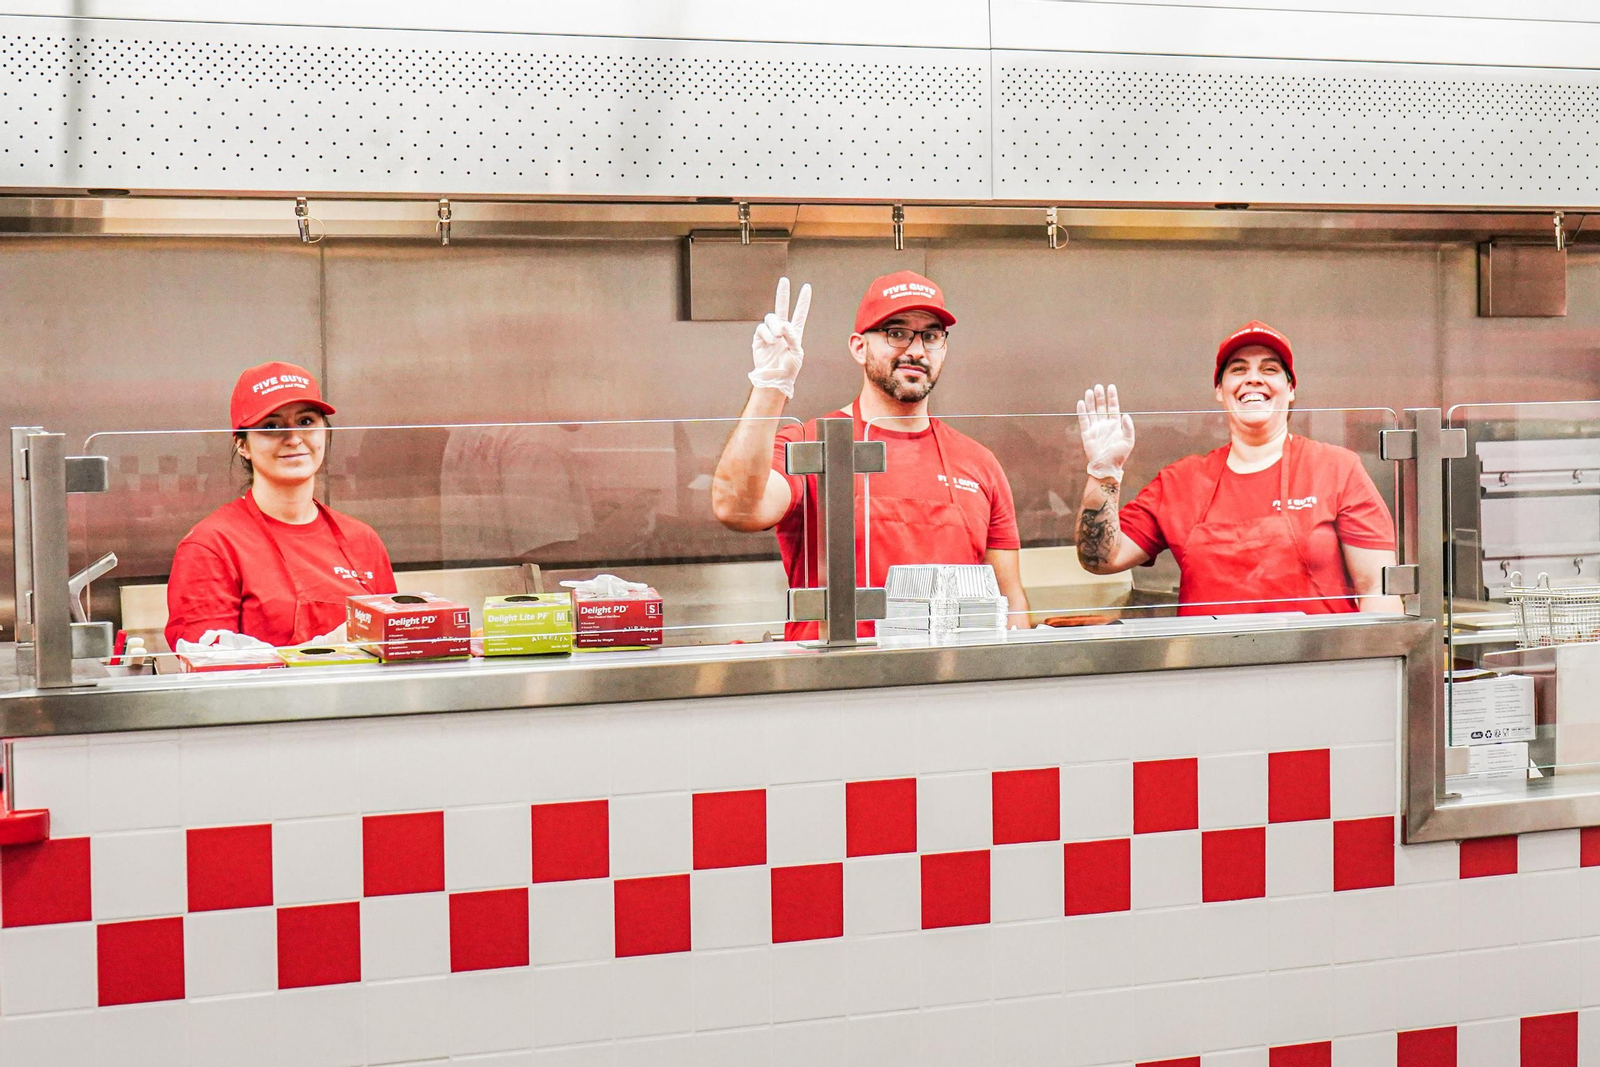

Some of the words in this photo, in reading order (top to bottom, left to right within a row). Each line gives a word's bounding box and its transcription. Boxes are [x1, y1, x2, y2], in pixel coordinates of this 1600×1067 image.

[882, 283, 907, 297] FIVE
[908, 282, 936, 296] GUYS
[252, 376, 279, 393] FIVE
[280, 374, 310, 385] GUYS
[958, 478, 979, 489] GUYS
[1293, 496, 1317, 506] GUYS
[351, 570, 374, 579] GS
[580, 606, 612, 616] Delight
[613, 605, 627, 614] PD
[649, 605, 655, 614] S
[388, 616, 420, 627] Delight
[421, 615, 436, 624] PD
[458, 613, 464, 623] L
[487, 614, 518, 624] Delight
[519, 613, 535, 621] Lite
[537, 612, 548, 620] PF
[556, 611, 565, 621] M
